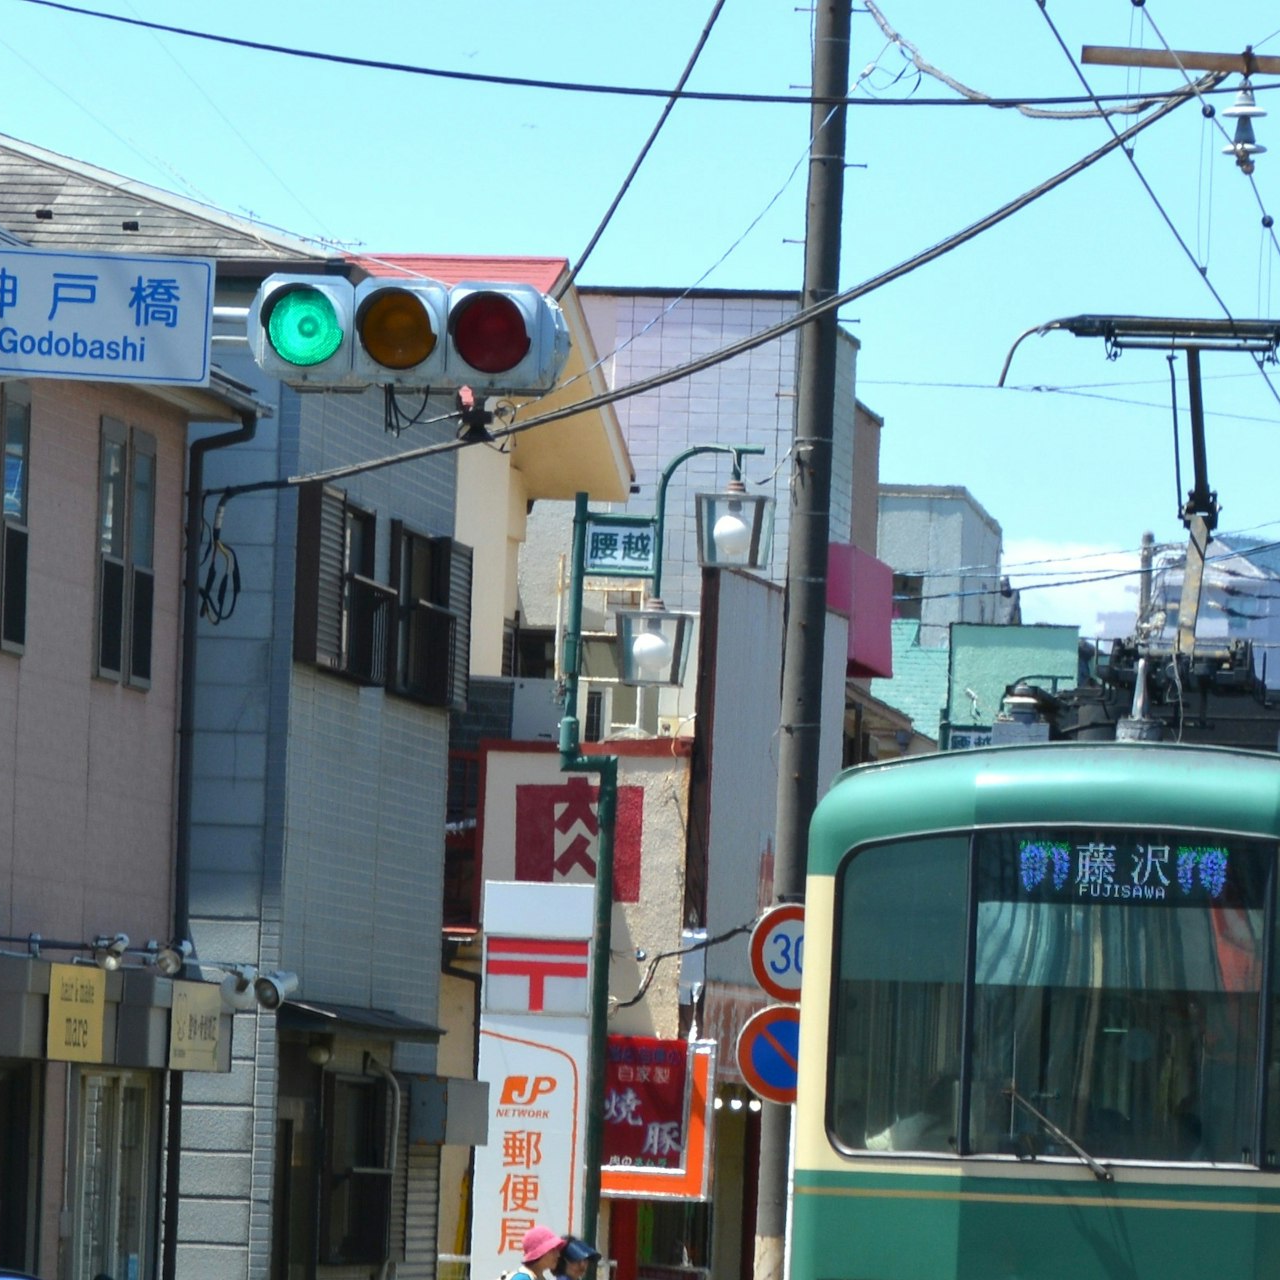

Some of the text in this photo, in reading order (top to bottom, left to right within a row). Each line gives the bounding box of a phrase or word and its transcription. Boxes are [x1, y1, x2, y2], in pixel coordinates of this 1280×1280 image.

[590, 532, 651, 561] 腰越
[515, 776, 644, 902] 肉
[1075, 842, 1171, 886] 藤沢
[1078, 884, 1166, 899] FUJISAWA
[617, 1064, 671, 1084] 自家製
[500, 1075, 558, 1106] JP
[496, 1108, 550, 1119] NETWORK
[497, 1129, 542, 1256] 郵便局
